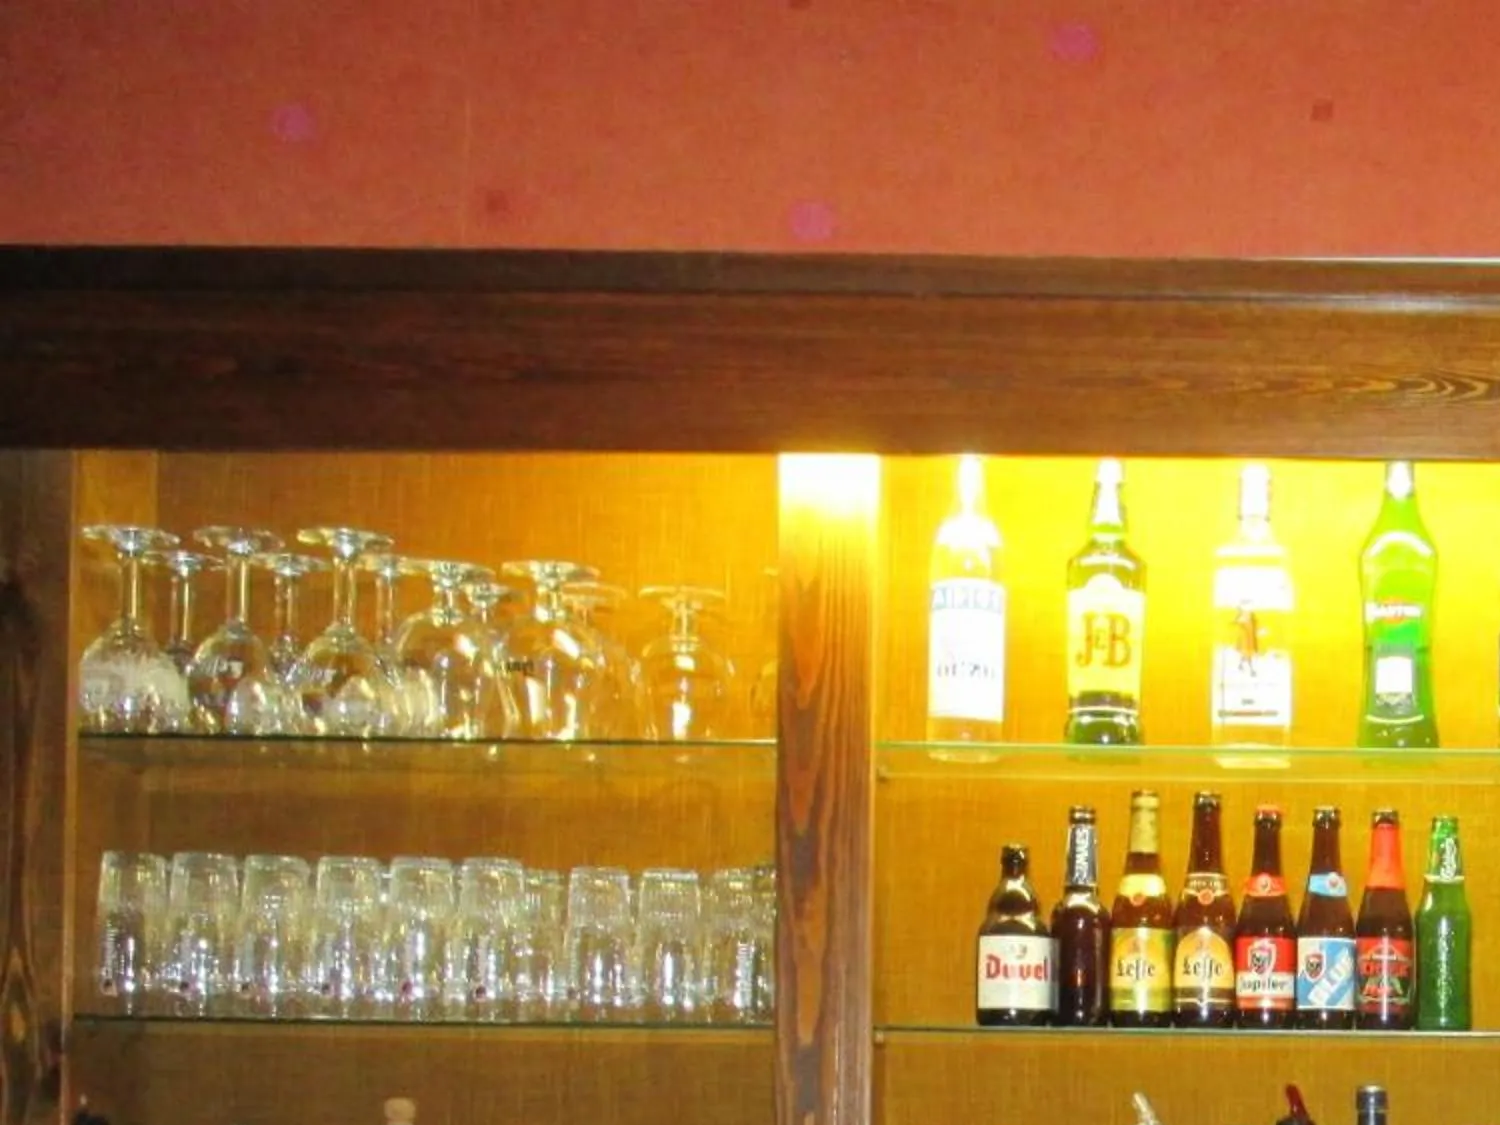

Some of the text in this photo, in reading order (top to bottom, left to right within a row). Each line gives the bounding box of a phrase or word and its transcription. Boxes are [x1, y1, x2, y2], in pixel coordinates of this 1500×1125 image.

[985, 953, 1049, 982] Duvel
[1116, 955, 1156, 981] Leffe
[1182, 953, 1224, 983] Leffe
